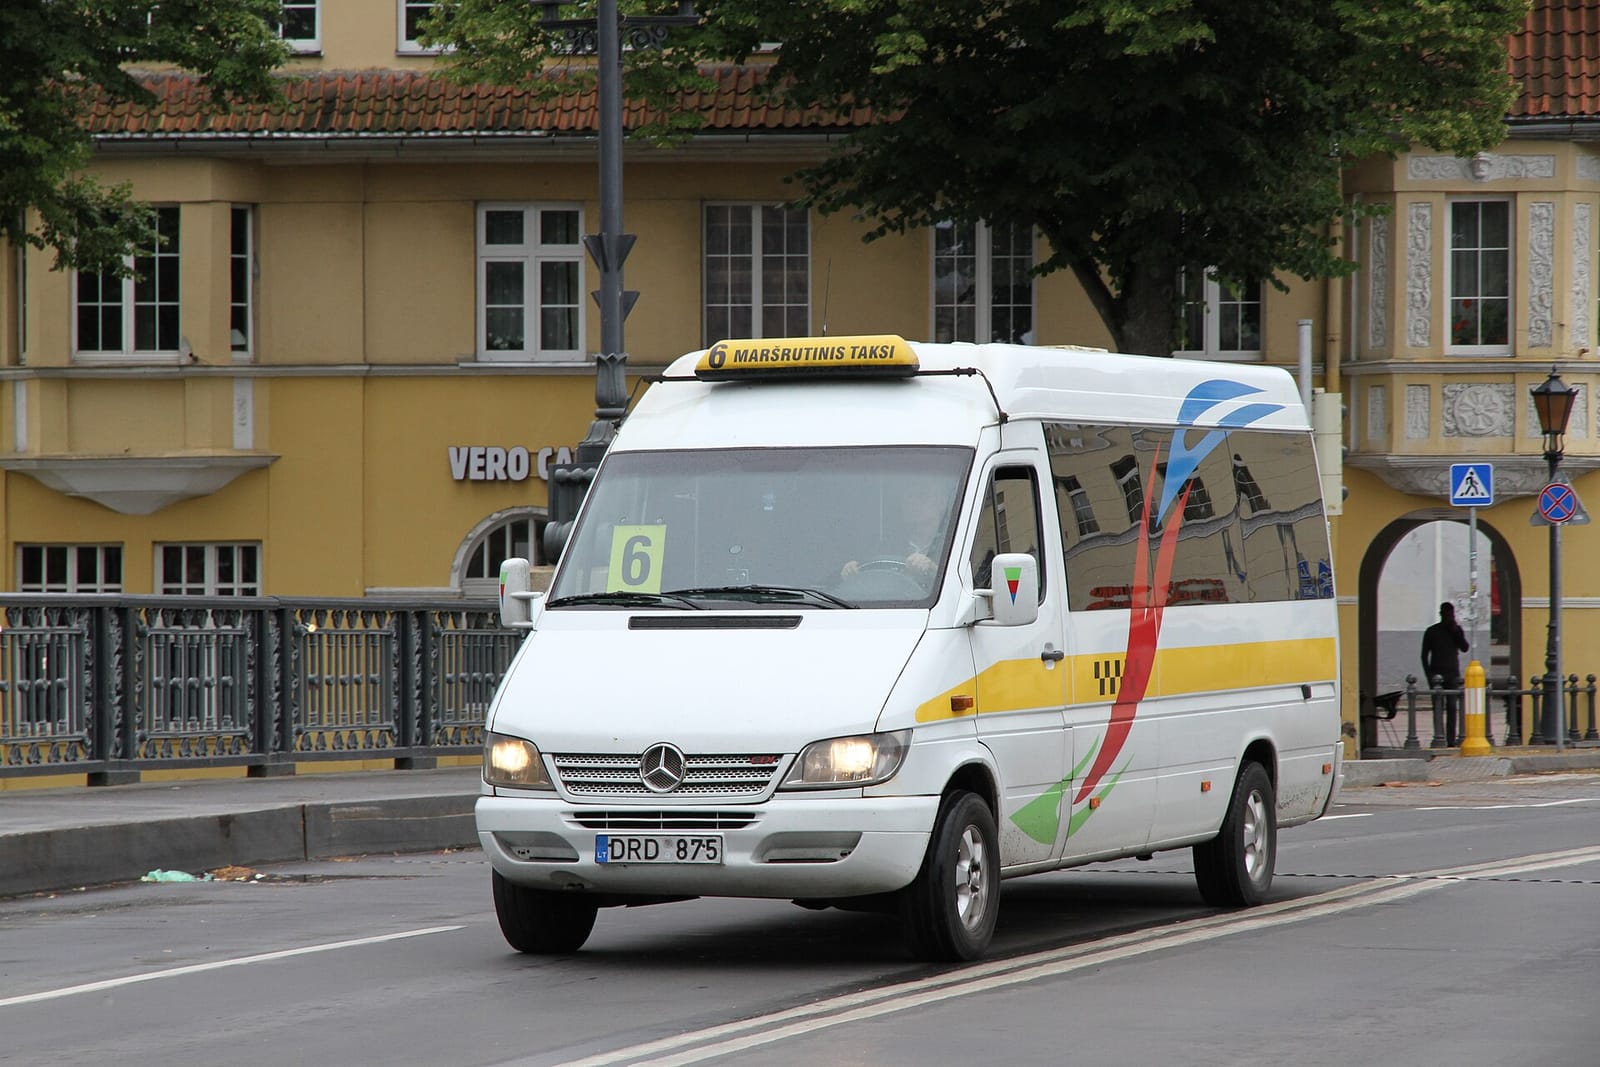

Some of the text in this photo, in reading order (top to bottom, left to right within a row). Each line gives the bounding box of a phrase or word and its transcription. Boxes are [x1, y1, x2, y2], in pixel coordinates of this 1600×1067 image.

[708, 343, 895, 368] 6 MARŠRUTINIS TAKSI
[448, 446, 575, 480] VERO CA
[621, 535, 652, 586] 6
[610, 838, 718, 860] DRD 875
